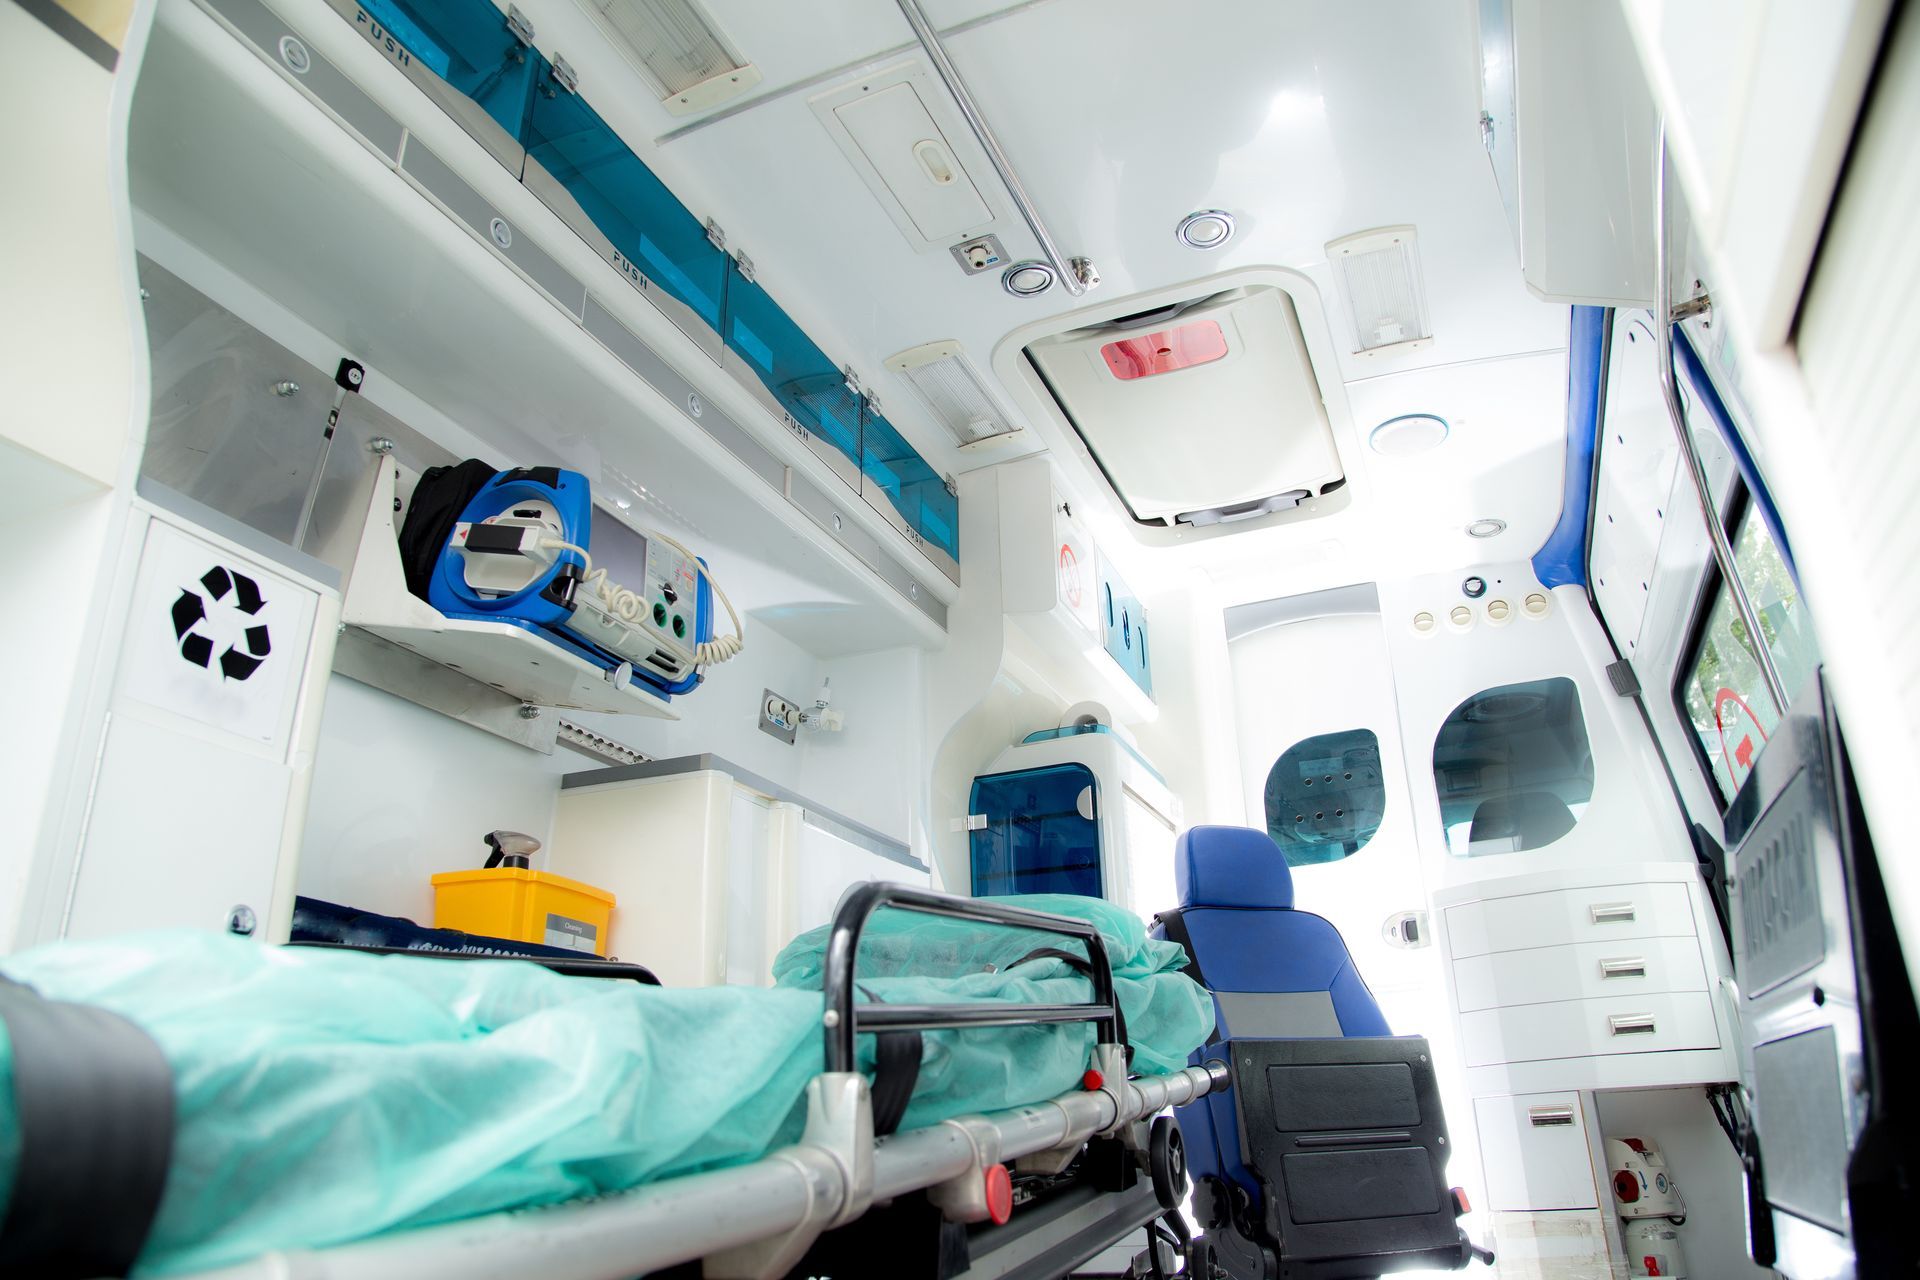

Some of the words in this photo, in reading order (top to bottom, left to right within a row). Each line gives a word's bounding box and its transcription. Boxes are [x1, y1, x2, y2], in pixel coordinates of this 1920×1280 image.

[357, 9, 410, 66] PUSH
[613, 250, 648, 290] PUSH
[784, 411, 809, 441] PUSH
[905, 524, 925, 547] PUSH
